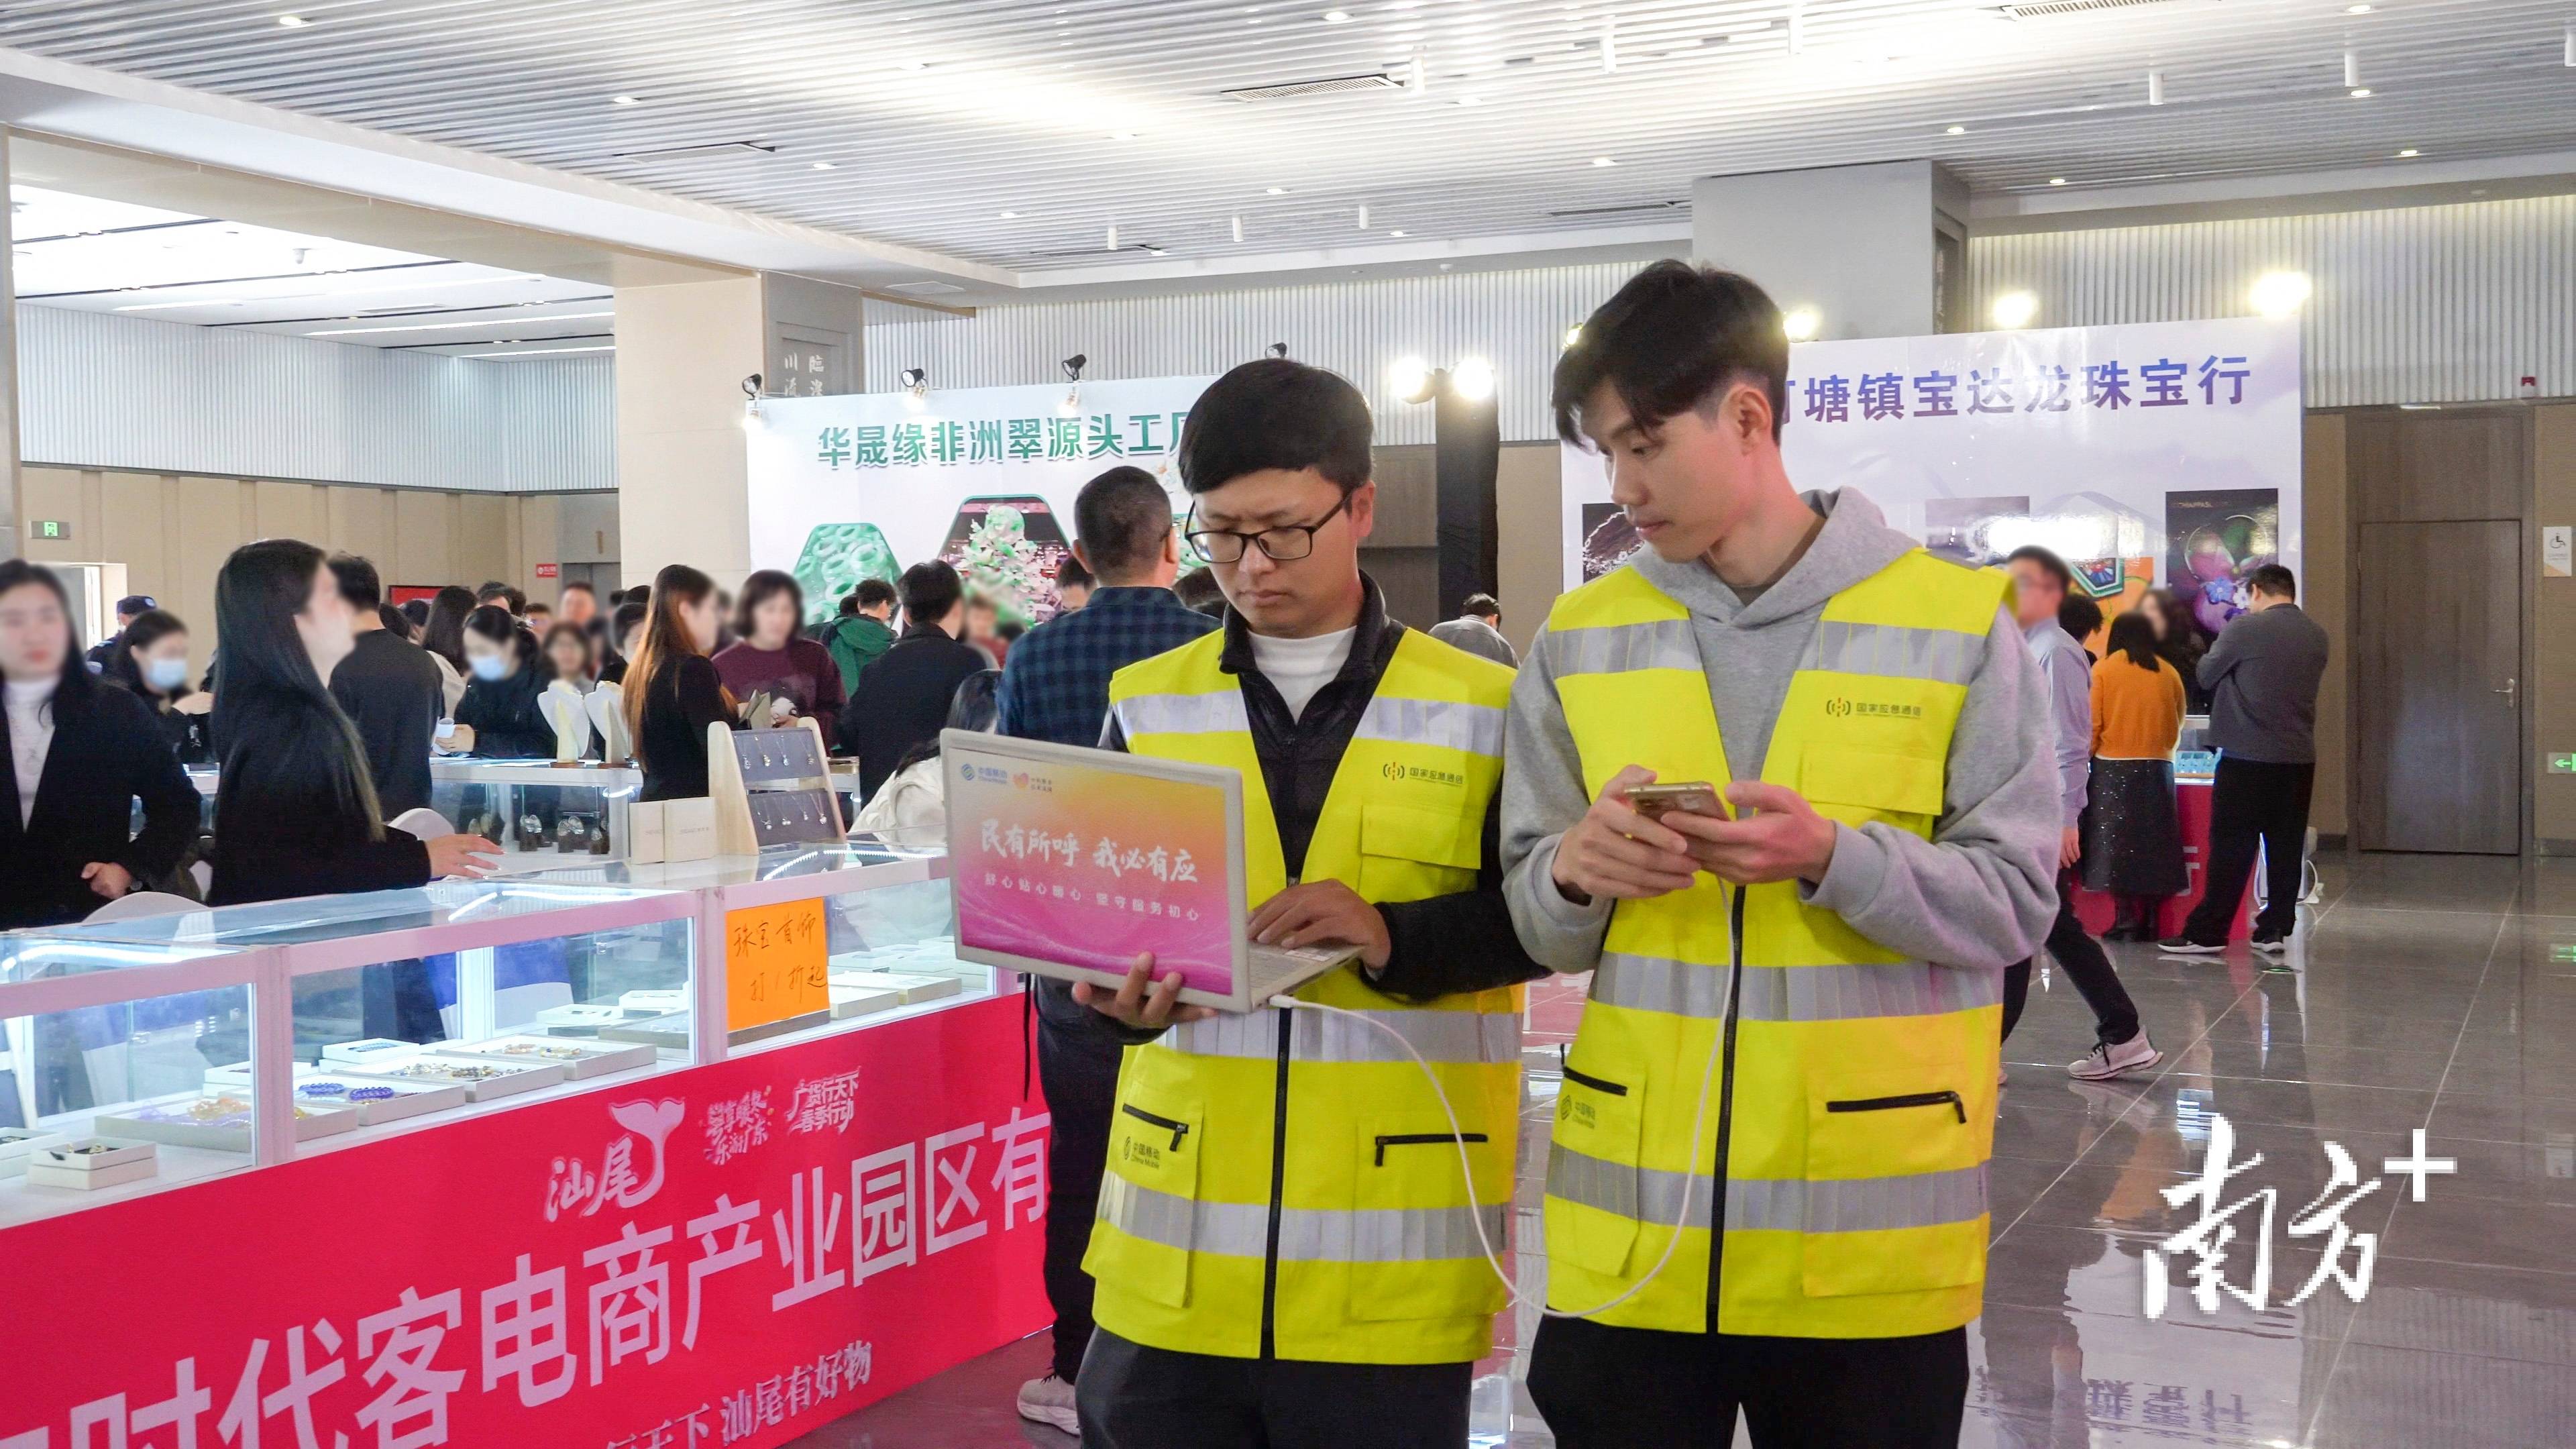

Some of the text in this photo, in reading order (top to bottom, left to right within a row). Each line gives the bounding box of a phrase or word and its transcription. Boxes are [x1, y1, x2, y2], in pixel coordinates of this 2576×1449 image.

[981, 818, 1197, 882] 民有所呼 我必有应
[0, 1107, 1052, 1449] 时代客电商产业园区有
[720, 1340, 872, 1447] 汕尾有好物
